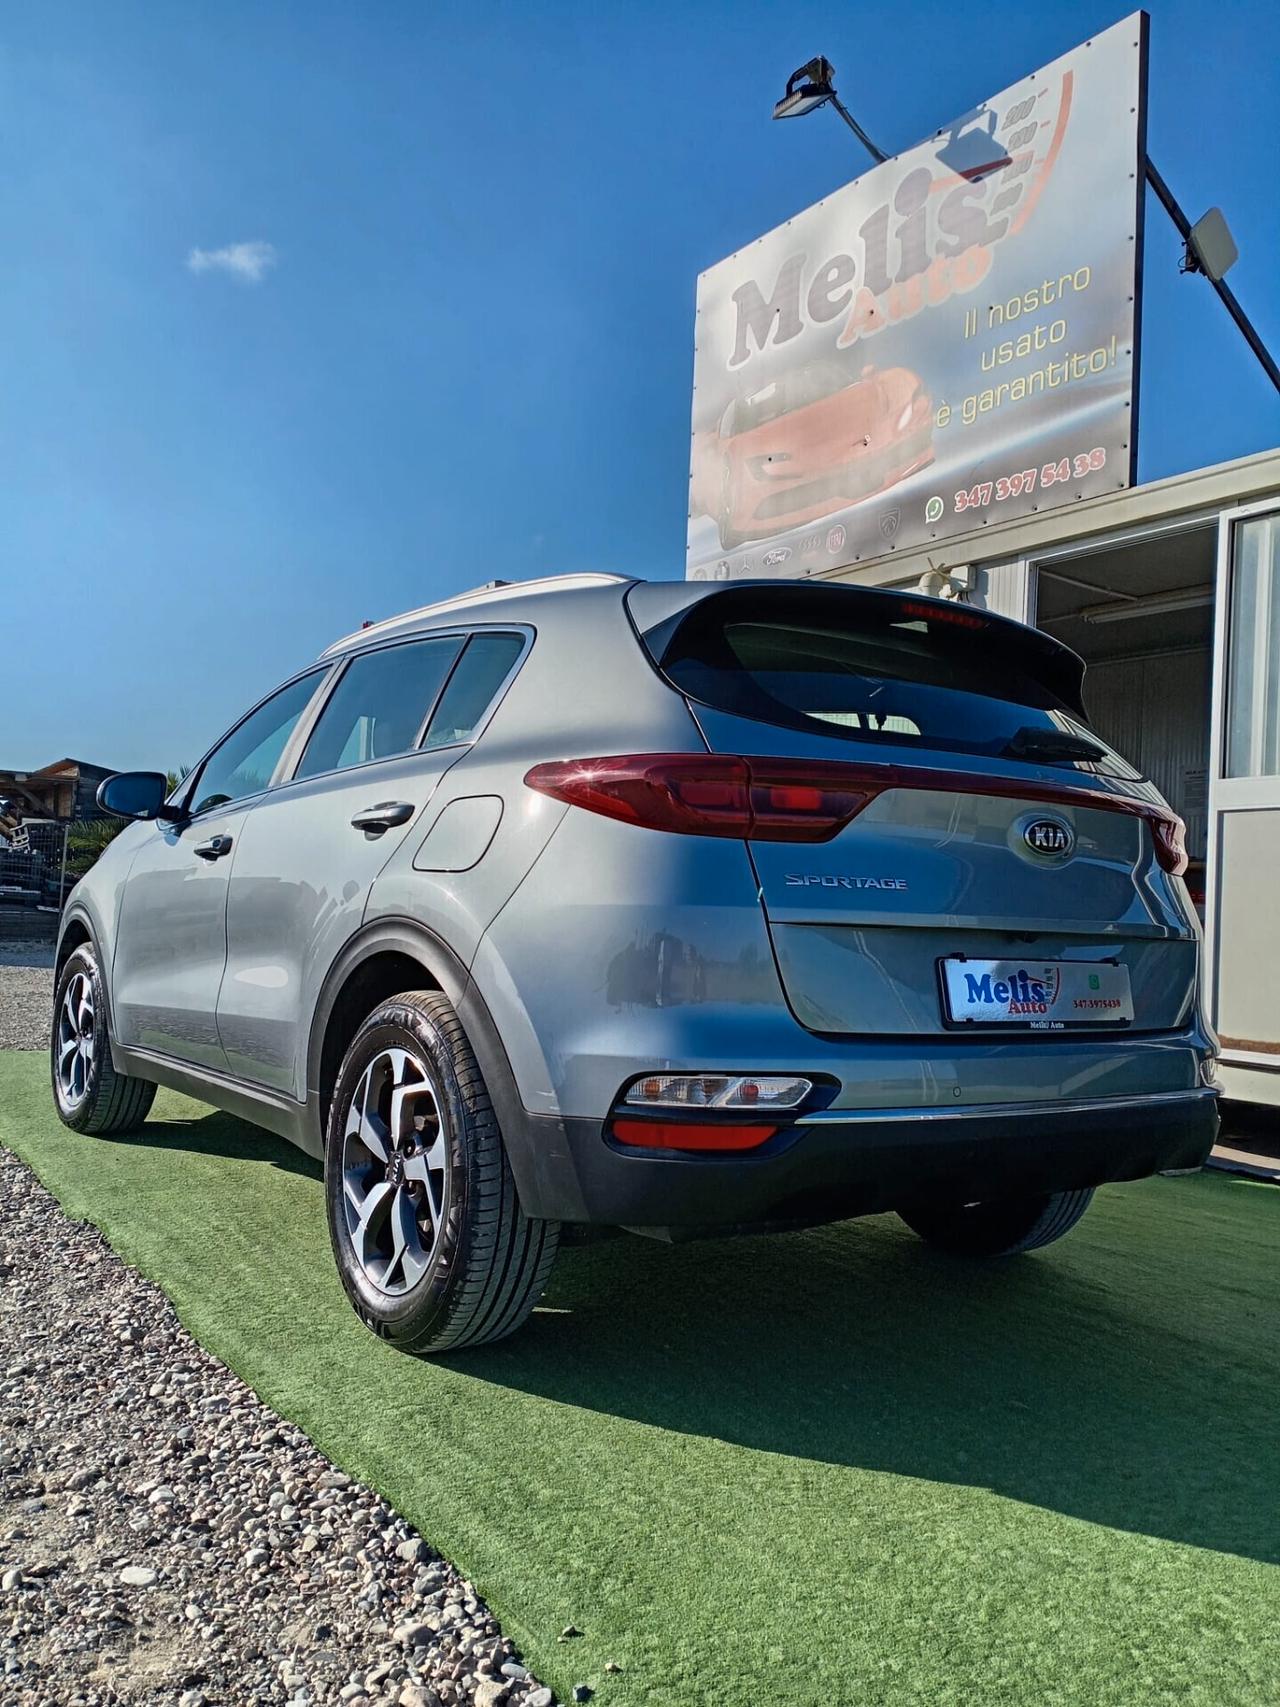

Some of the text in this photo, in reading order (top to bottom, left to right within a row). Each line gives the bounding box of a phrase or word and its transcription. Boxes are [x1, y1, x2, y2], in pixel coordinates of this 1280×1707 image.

[729, 168, 997, 366] Melis
[839, 246, 992, 348] Auto
[964, 267, 1090, 338] Il nostro
[981, 320, 1066, 370] usato
[936, 335, 1117, 427] è garantito!
[954, 448, 1106, 512] 347 397 54 38
[764, 551, 788, 566] Ford
[1034, 826, 1070, 847] KIA
[784, 873, 907, 890] SPORTAGE
[964, 970, 1045, 1003] Melis
[1008, 998, 1047, 1014] Auto
